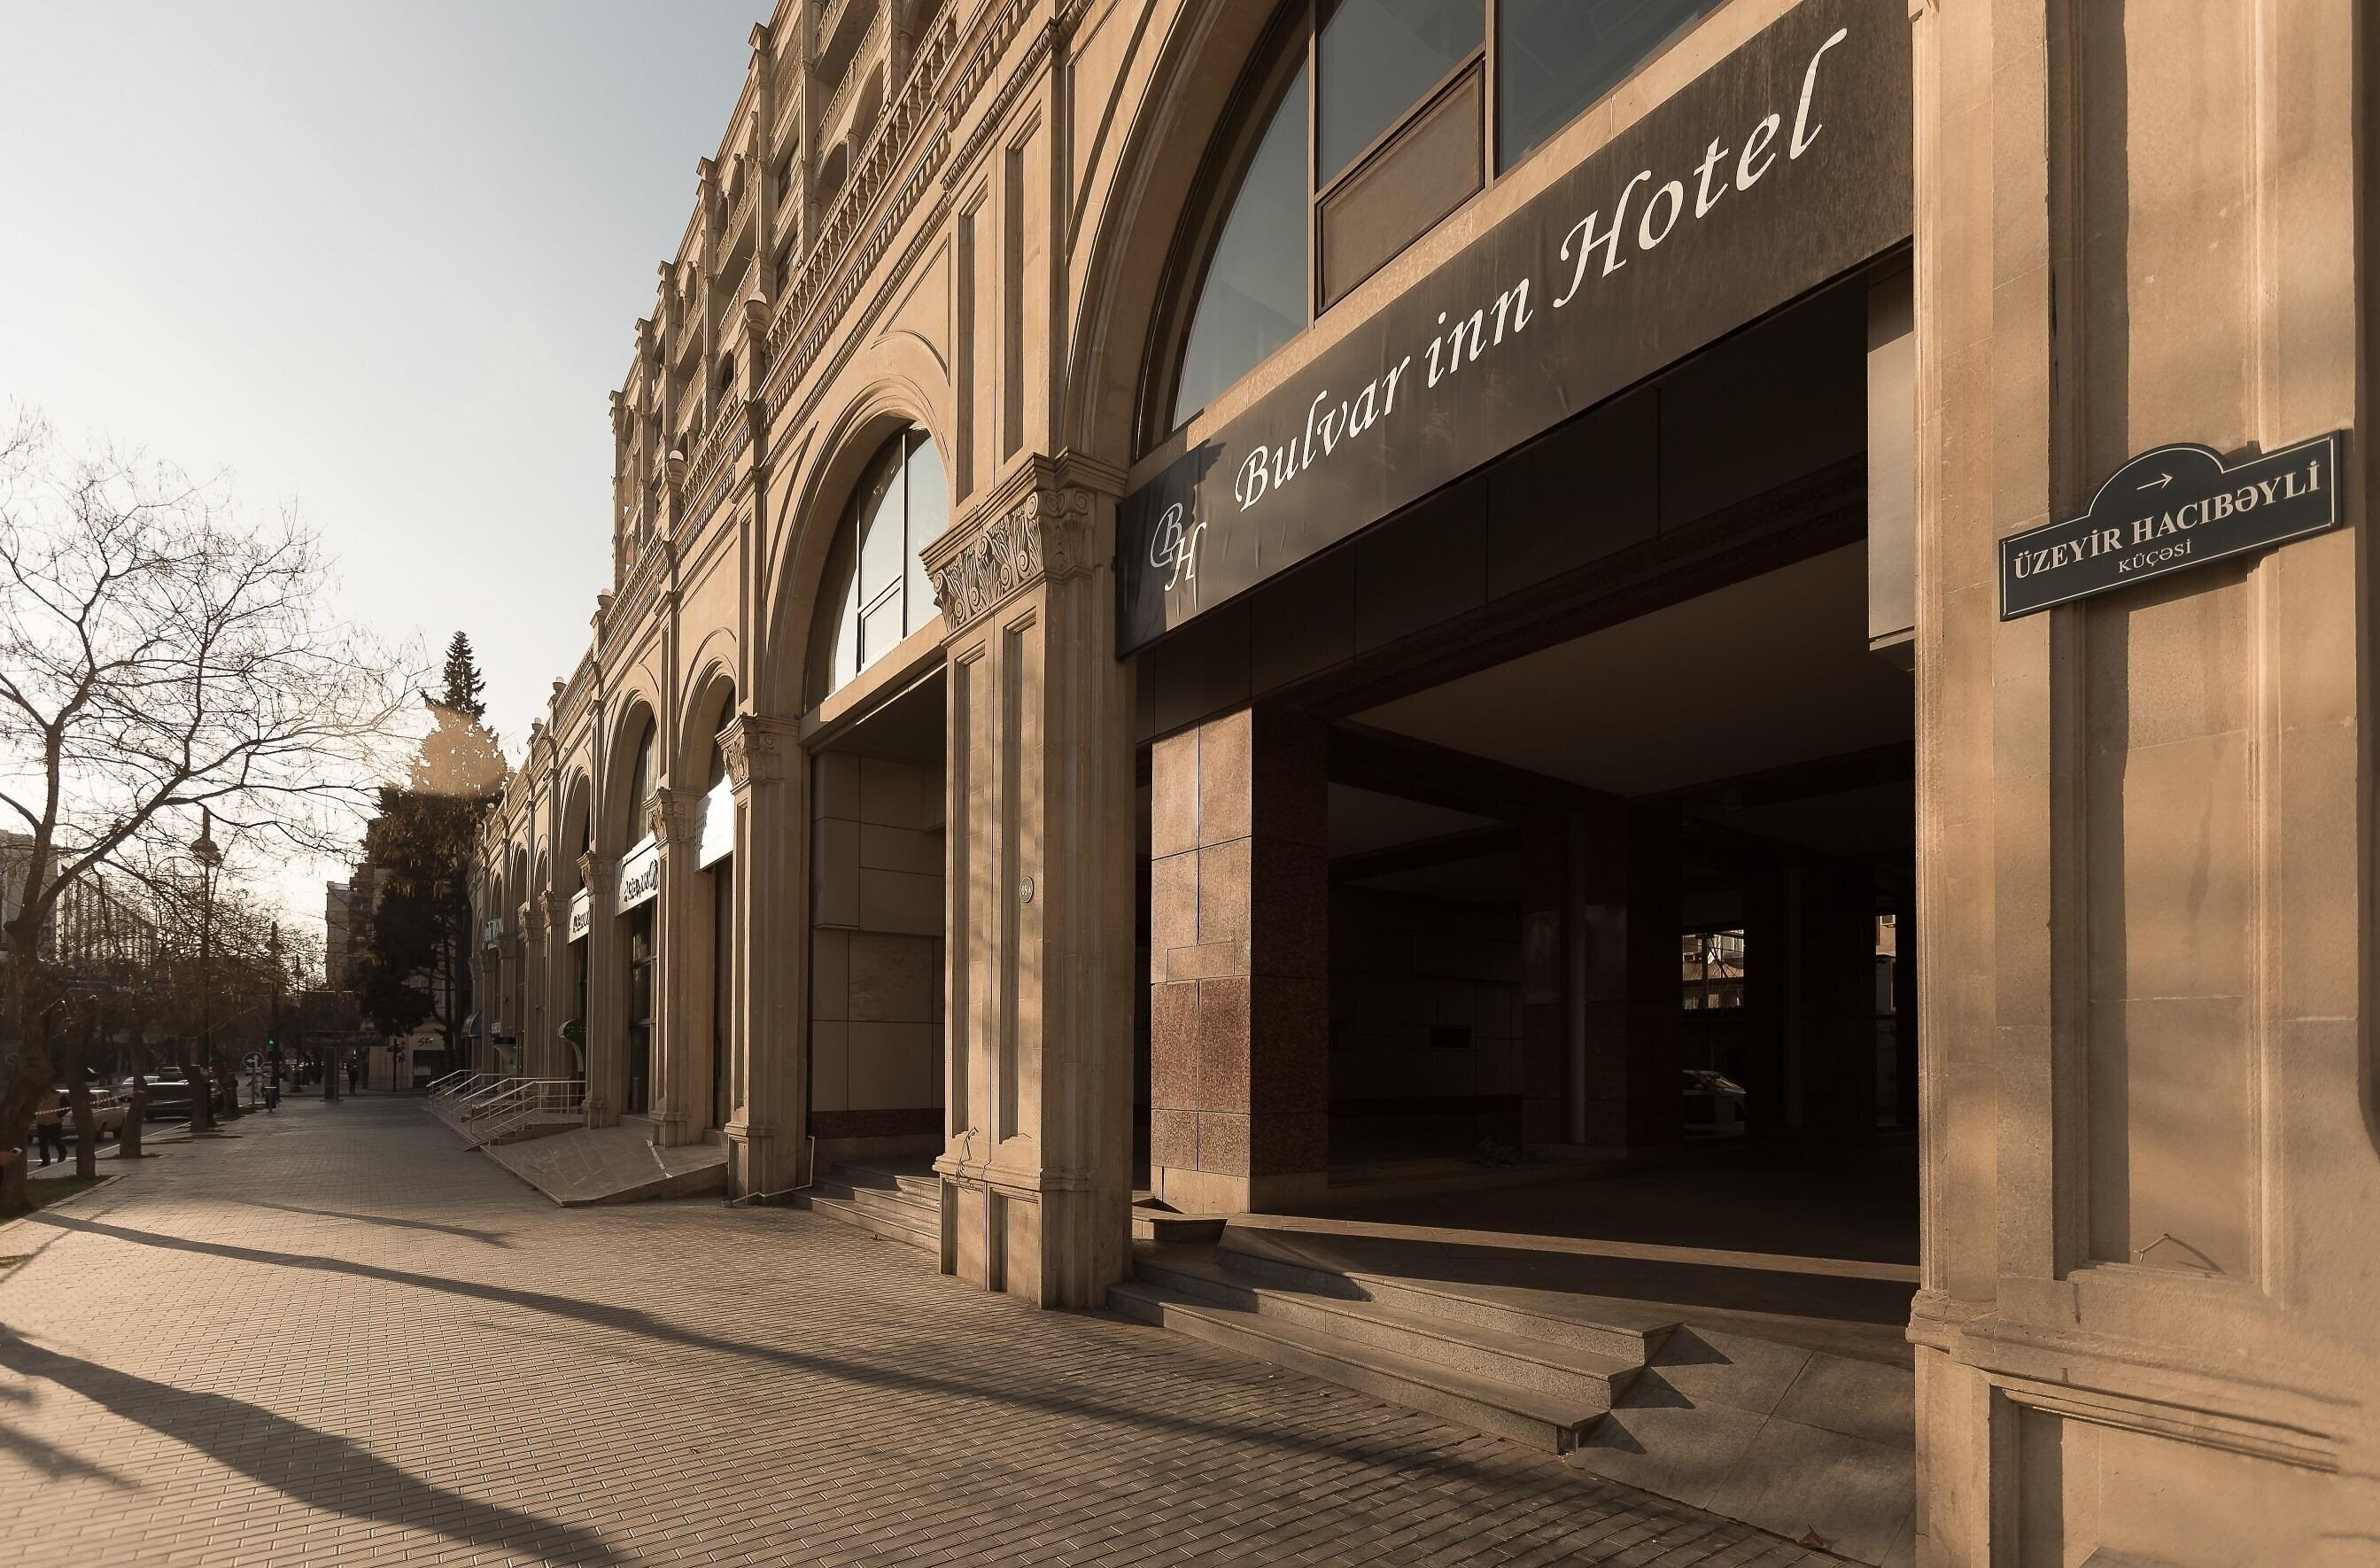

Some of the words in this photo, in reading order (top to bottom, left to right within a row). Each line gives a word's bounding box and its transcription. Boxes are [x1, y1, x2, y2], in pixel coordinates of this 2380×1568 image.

[1235, 355, 1411, 512] Bulvar
[1424, 277, 1534, 389] inn
[1553, 27, 1848, 308] Hotel
[2013, 528, 2123, 578] ÜZEYİR
[2131, 460, 2321, 546] HACIBƏYLİ
